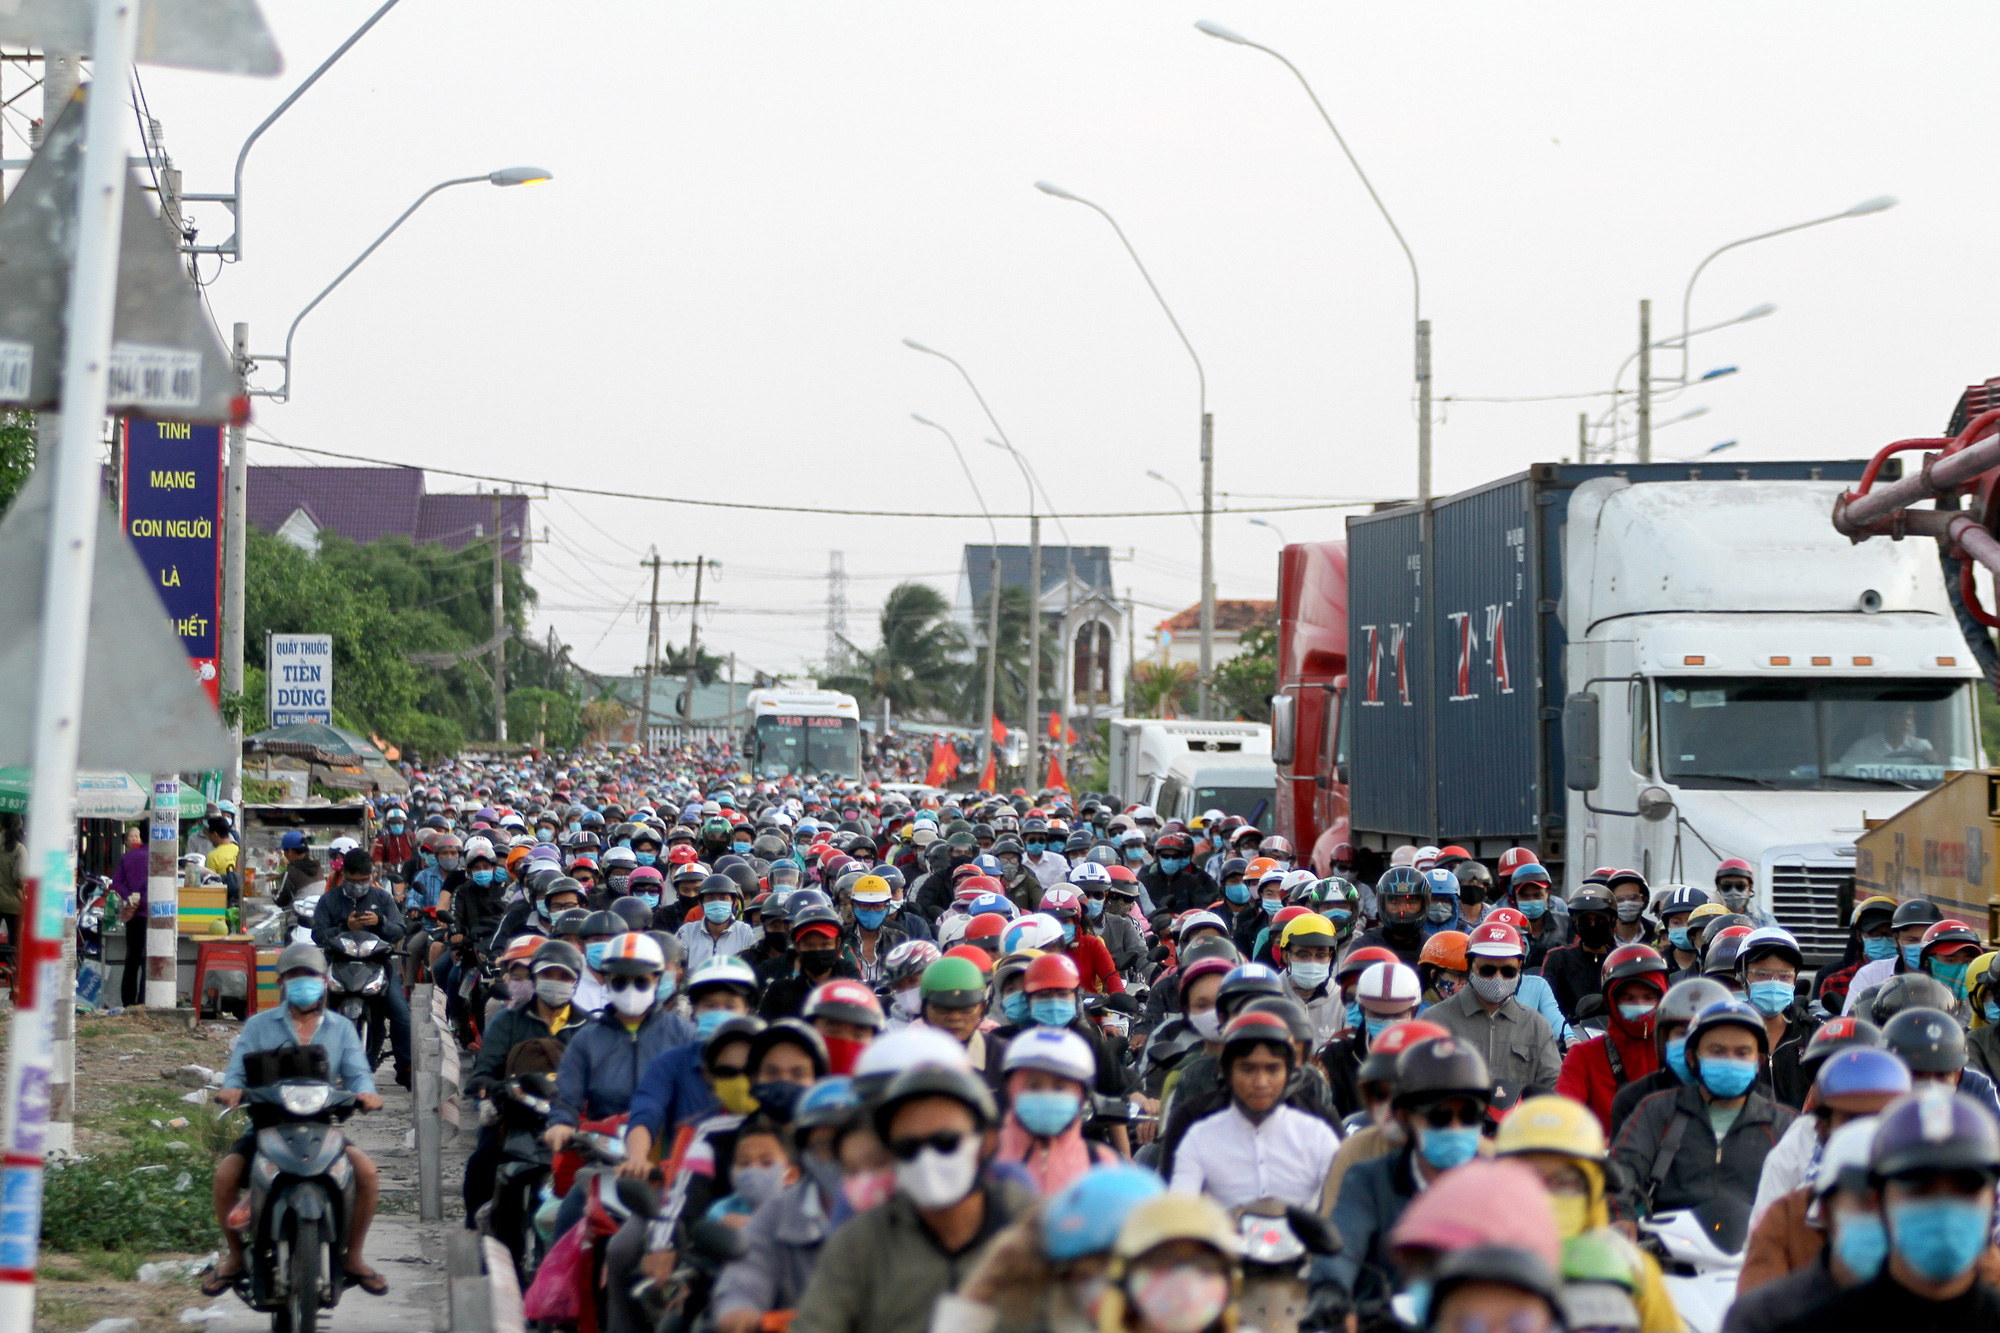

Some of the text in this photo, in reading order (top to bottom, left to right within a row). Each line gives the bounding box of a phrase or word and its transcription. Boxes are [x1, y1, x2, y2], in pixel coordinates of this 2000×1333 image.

[150, 470, 196, 492] MẠNG
[132, 515, 212, 538] CON NGƯỜI
[161, 564, 181, 587] LÀ
[178, 613, 208, 637] HẾT
